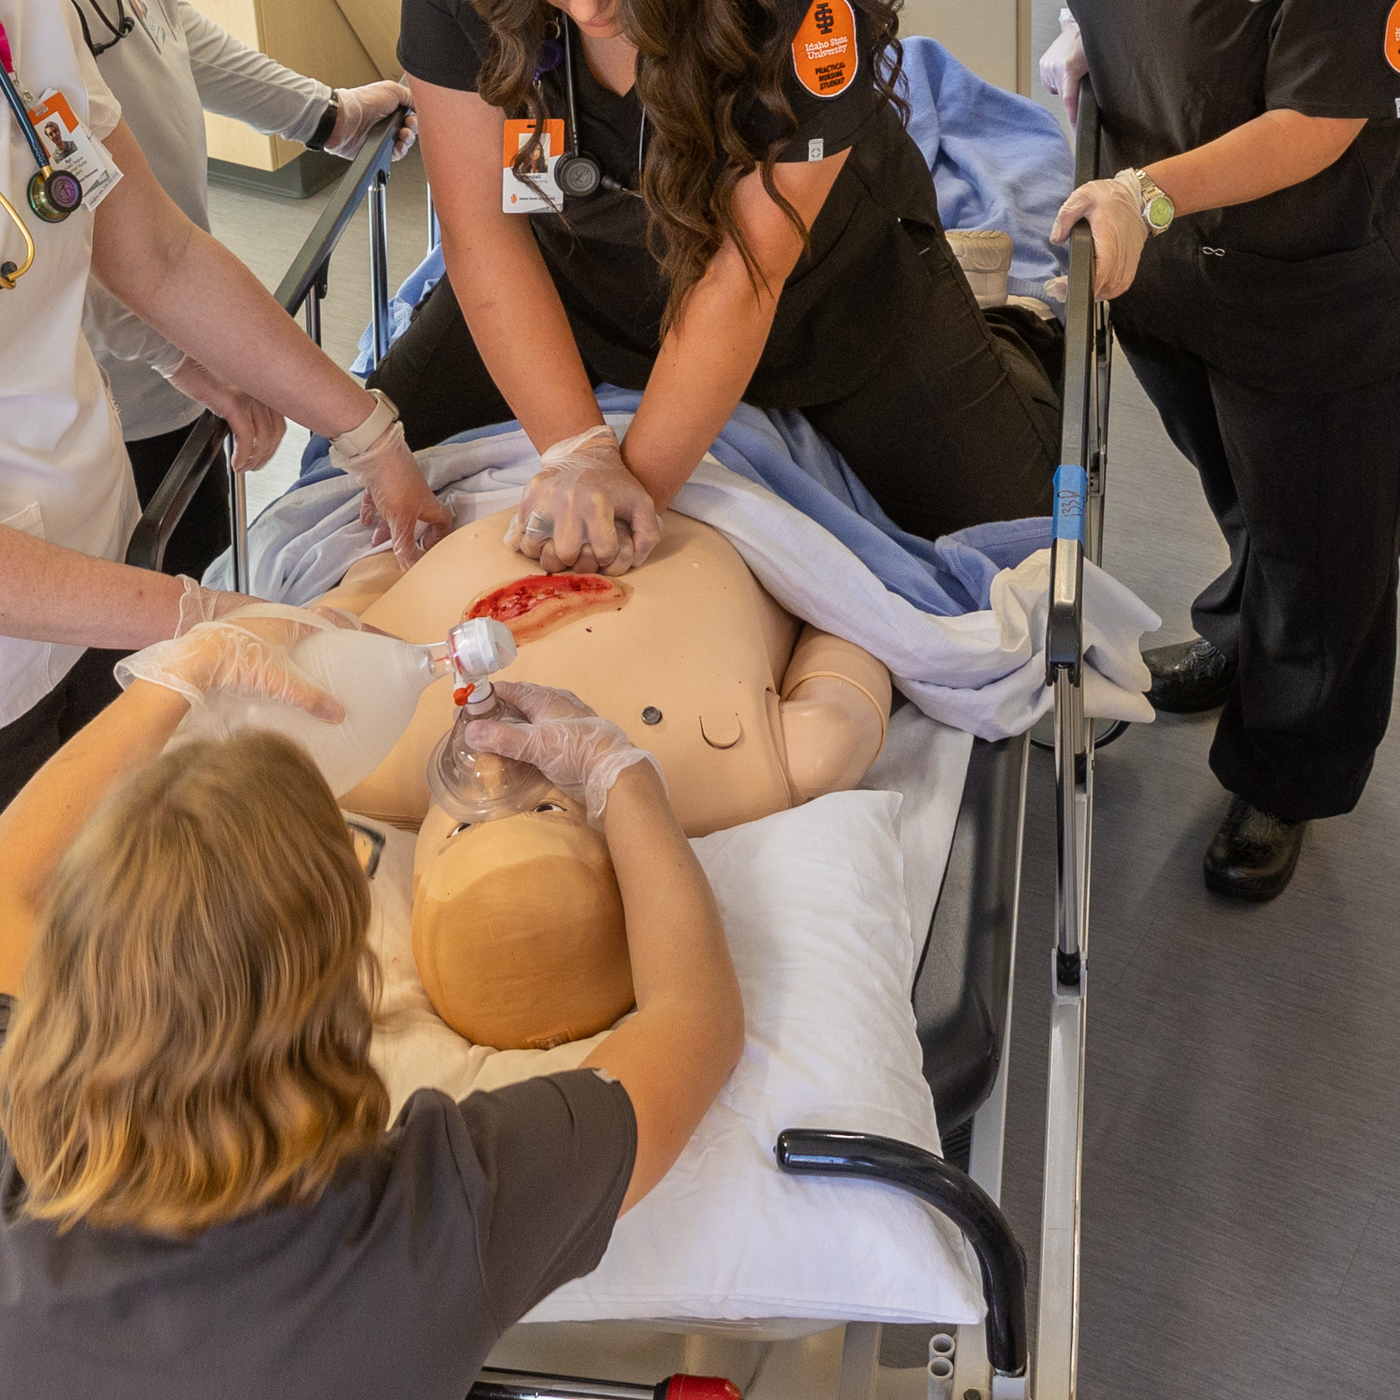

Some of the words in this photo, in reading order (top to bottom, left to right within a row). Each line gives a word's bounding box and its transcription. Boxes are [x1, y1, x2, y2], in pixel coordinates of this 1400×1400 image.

[804, 40, 830, 52] Idaho
[830, 36, 848, 46] State
[806, 44, 848, 60] University
[815, 61, 846, 75] PRACTICAL
[818, 70, 843, 82] NURSING
[819, 77, 846, 90] STUDENT
